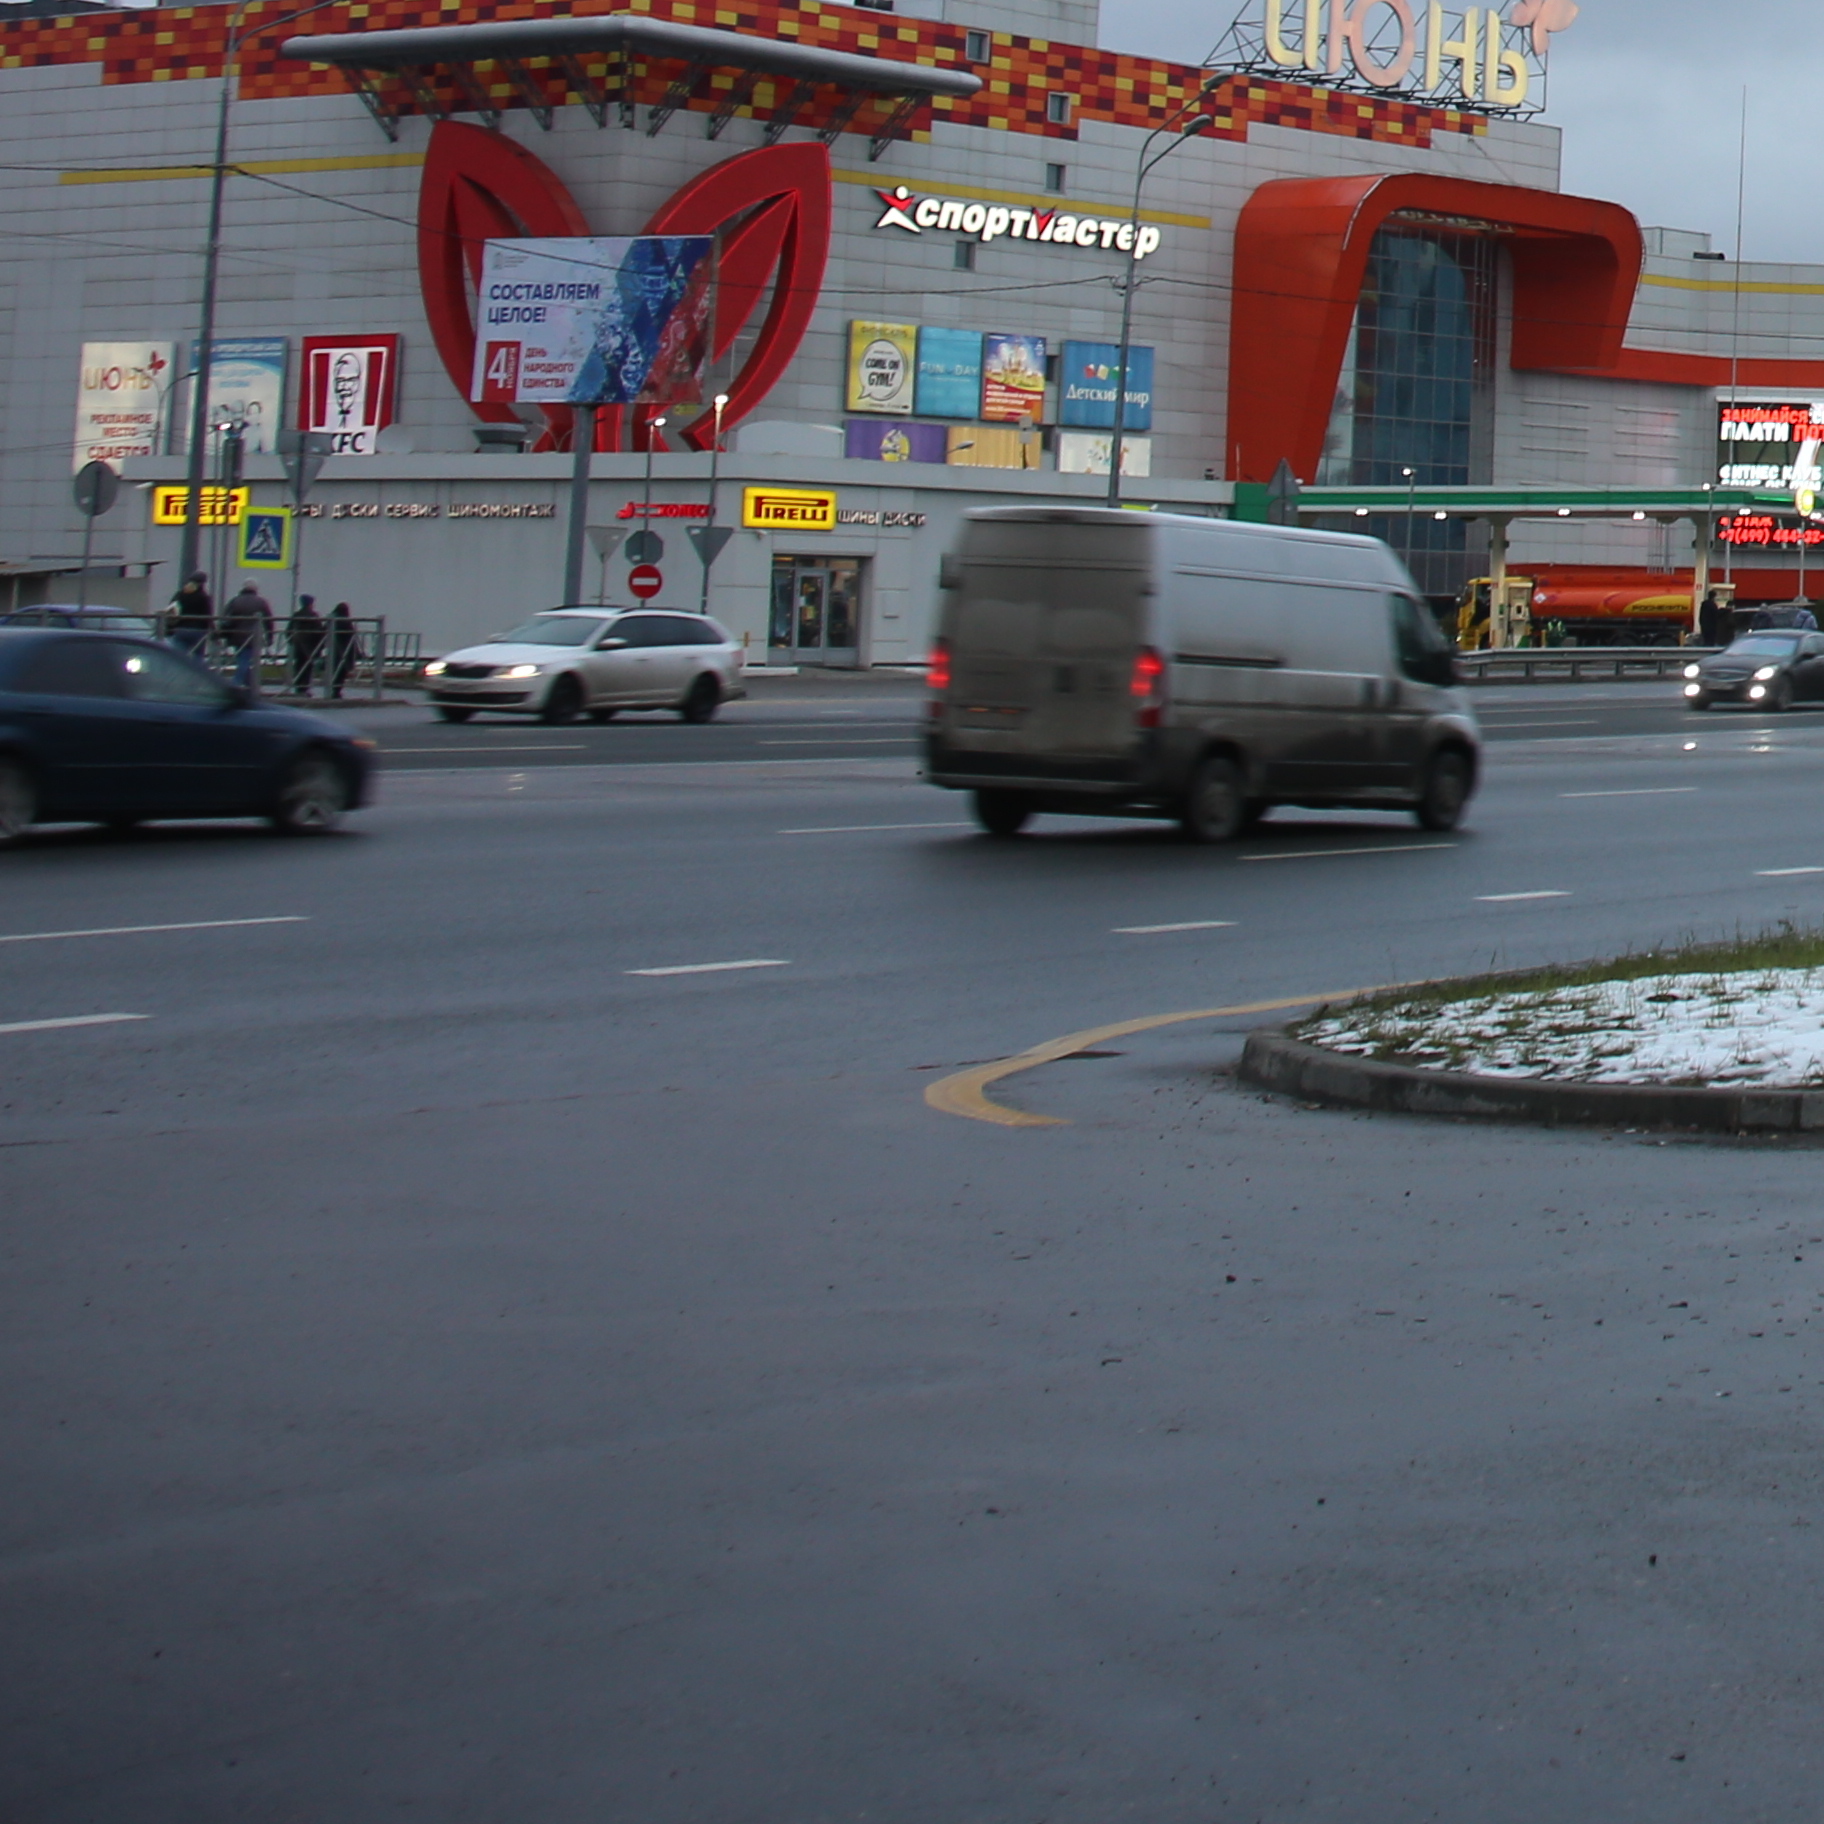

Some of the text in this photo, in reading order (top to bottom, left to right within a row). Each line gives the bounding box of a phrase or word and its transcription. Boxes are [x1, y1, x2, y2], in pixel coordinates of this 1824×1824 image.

[490, 283, 600, 301] СОСТАВЛЯЕМ
[488, 306, 547, 324] ЦЕЛОЕ!
[525, 347, 547, 358] ДЕНЬ
[523, 362, 575, 373] НАРОДНОГО
[955, 364, 979, 376] DAY
[1066, 383, 1119, 403] Детский
[1720, 421, 1790, 442] ПЛАТИ
[384, 504, 438, 517] СЕРВИС
[447, 504, 555, 518] ШИНОМОНТАЖ
[753, 496, 829, 522] PIRELLI
[837, 509, 926, 527] ШИНЫ ДИСКИ
